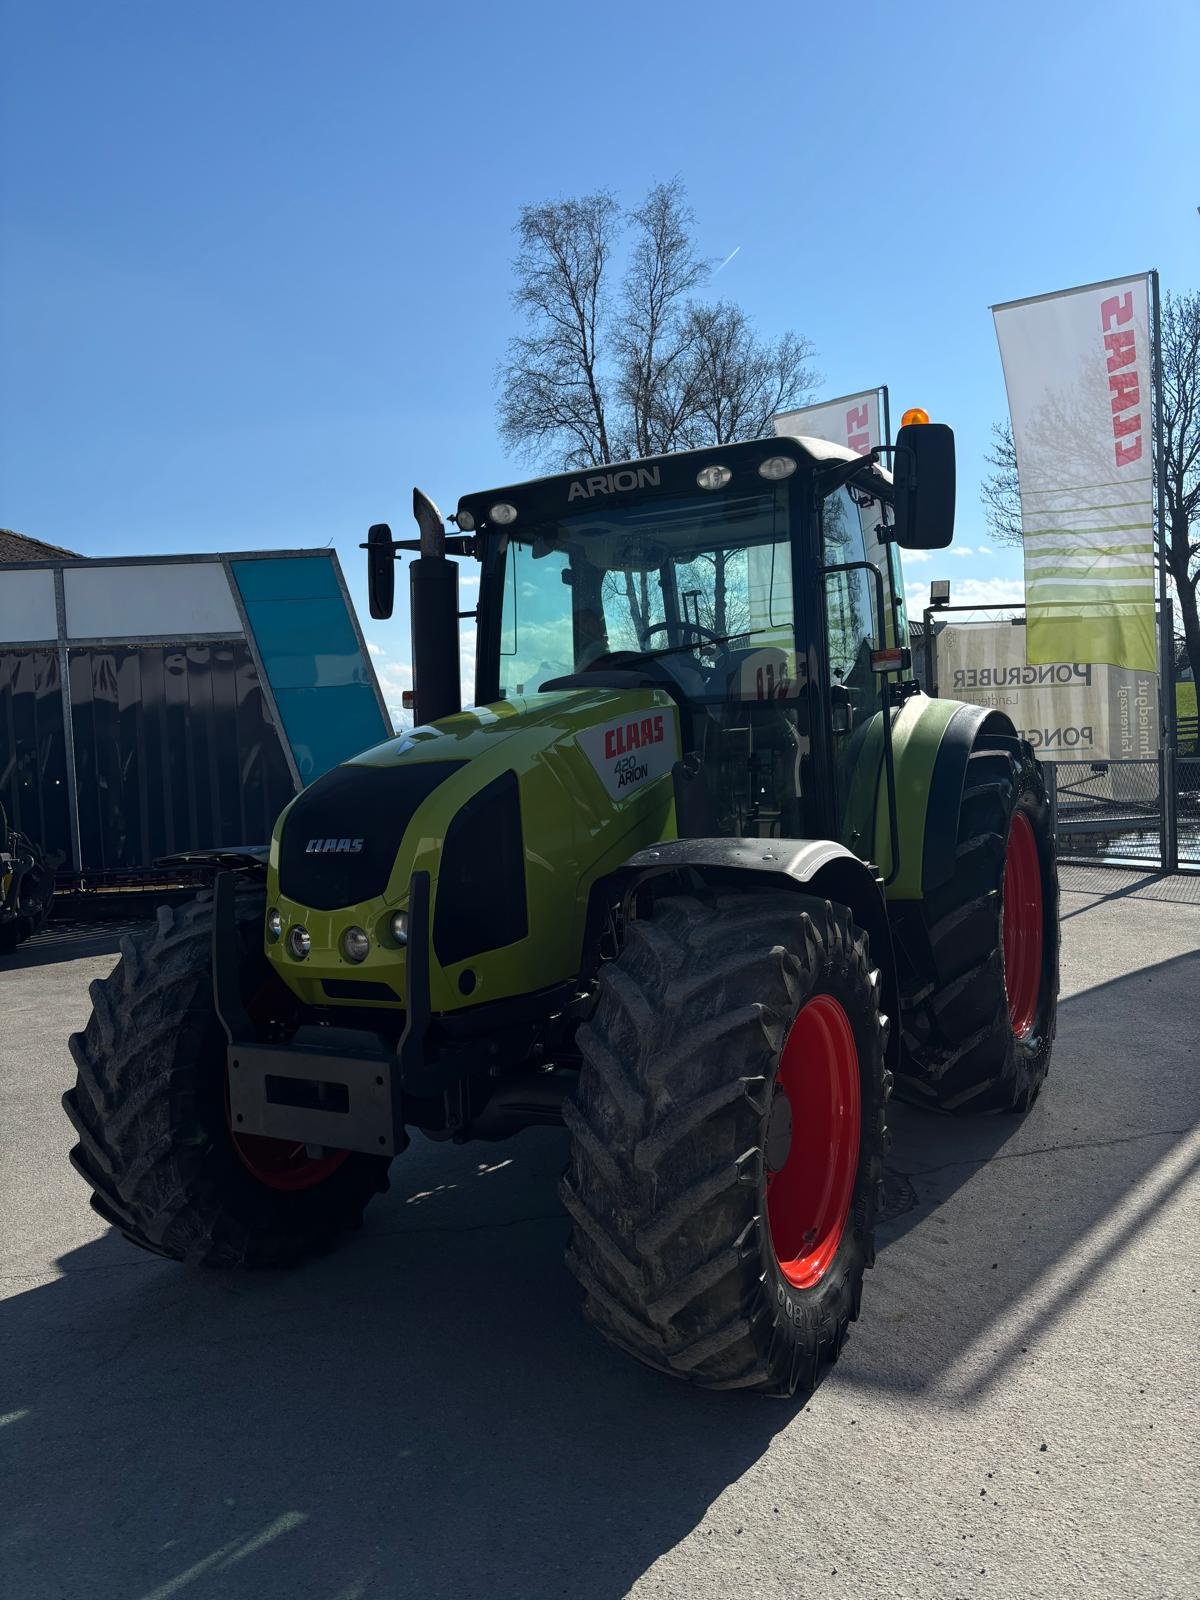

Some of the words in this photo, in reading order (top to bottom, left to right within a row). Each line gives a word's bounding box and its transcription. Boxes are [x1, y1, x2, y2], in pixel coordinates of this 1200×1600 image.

[567, 466, 660, 502] ARION
[605, 716, 664, 760] CLAAS
[614, 755, 637, 775] 420
[617, 763, 648, 788] ARION
[305, 838, 365, 853] CLAAS
